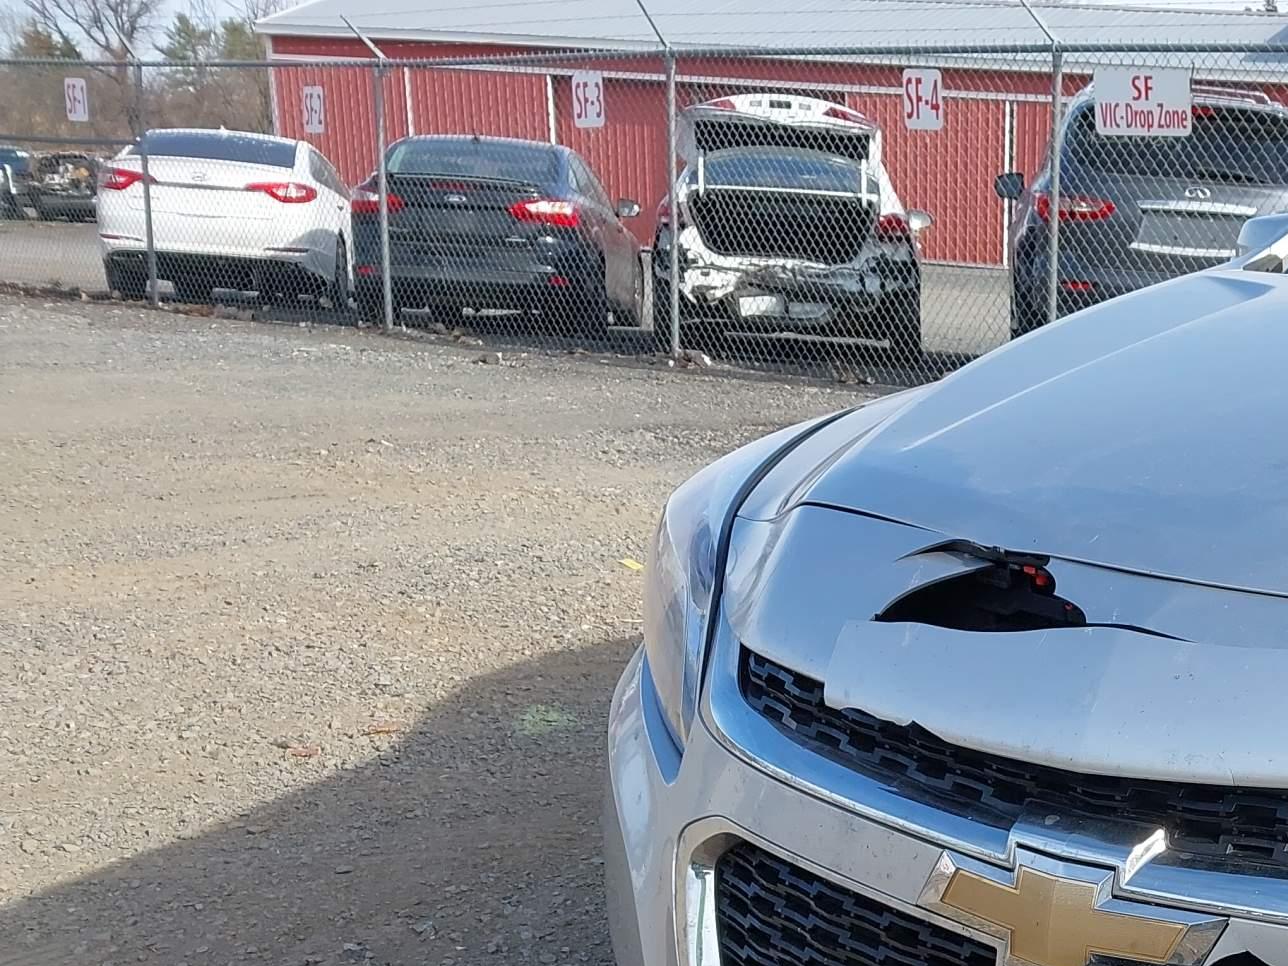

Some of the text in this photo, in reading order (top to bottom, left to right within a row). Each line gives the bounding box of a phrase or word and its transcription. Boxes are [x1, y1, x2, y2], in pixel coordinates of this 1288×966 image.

[67, 84, 86, 114] SF-1
[575, 82, 602, 119] SF-3
[905, 77, 940, 120] SF-4
[1132, 75, 1153, 101] SF
[305, 93, 322, 125] SF-2
[1101, 103, 1188, 132] VIC-Drop Zone
